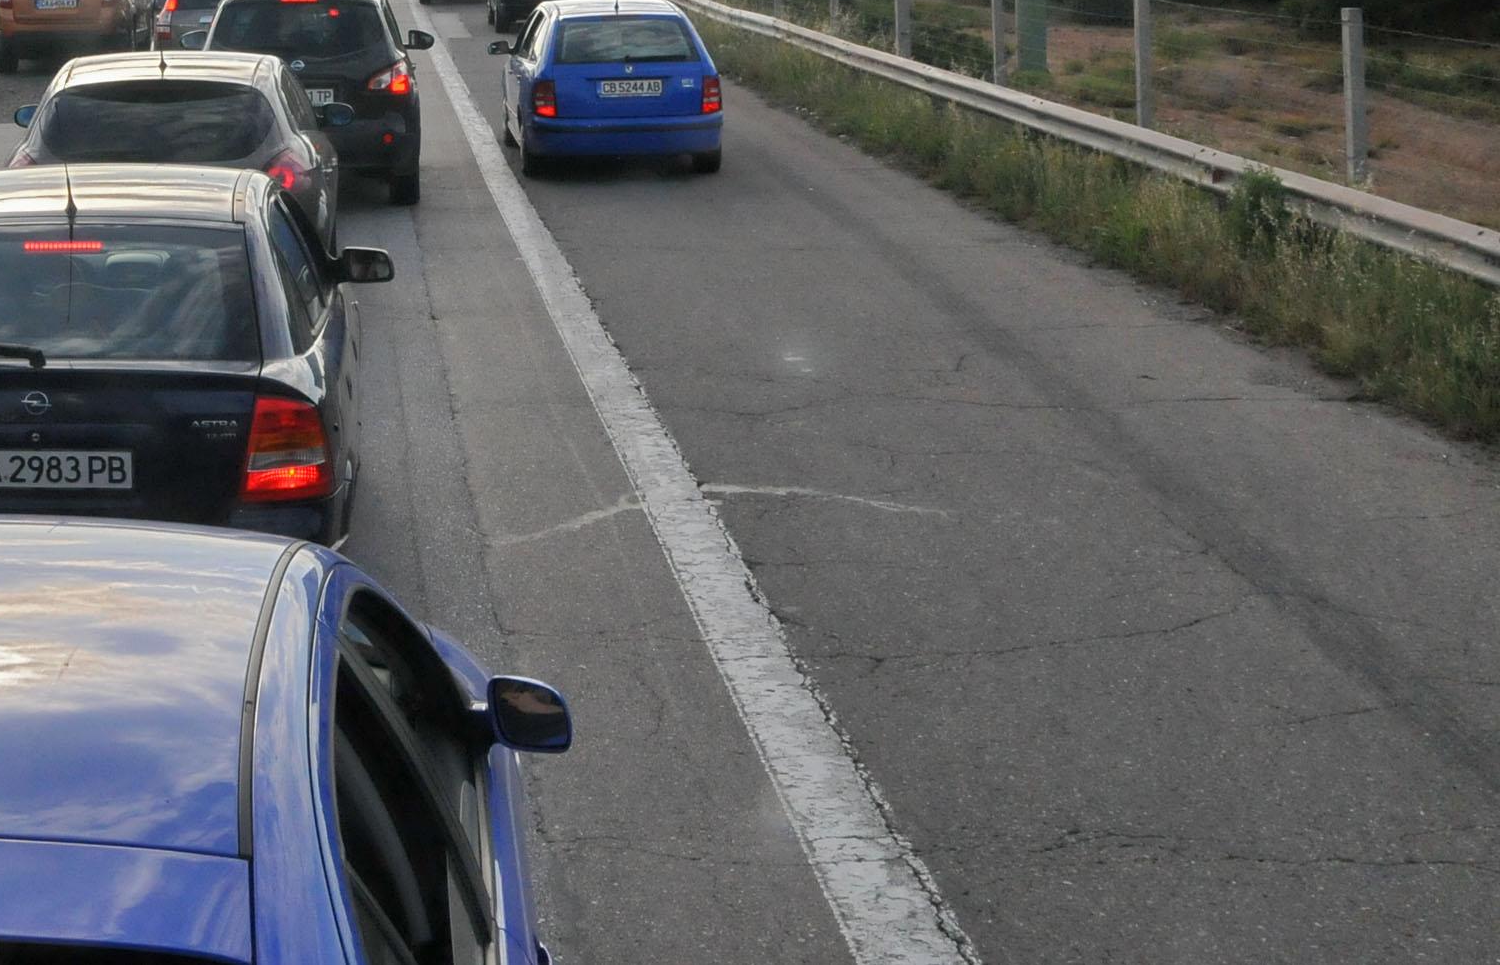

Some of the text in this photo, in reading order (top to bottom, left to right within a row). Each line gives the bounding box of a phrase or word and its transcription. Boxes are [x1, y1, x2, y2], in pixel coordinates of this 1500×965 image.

[603, 81, 661, 93] CB 5244 AB
[9, 455, 81, 483] 2983
[88, 455, 127, 483] PB
